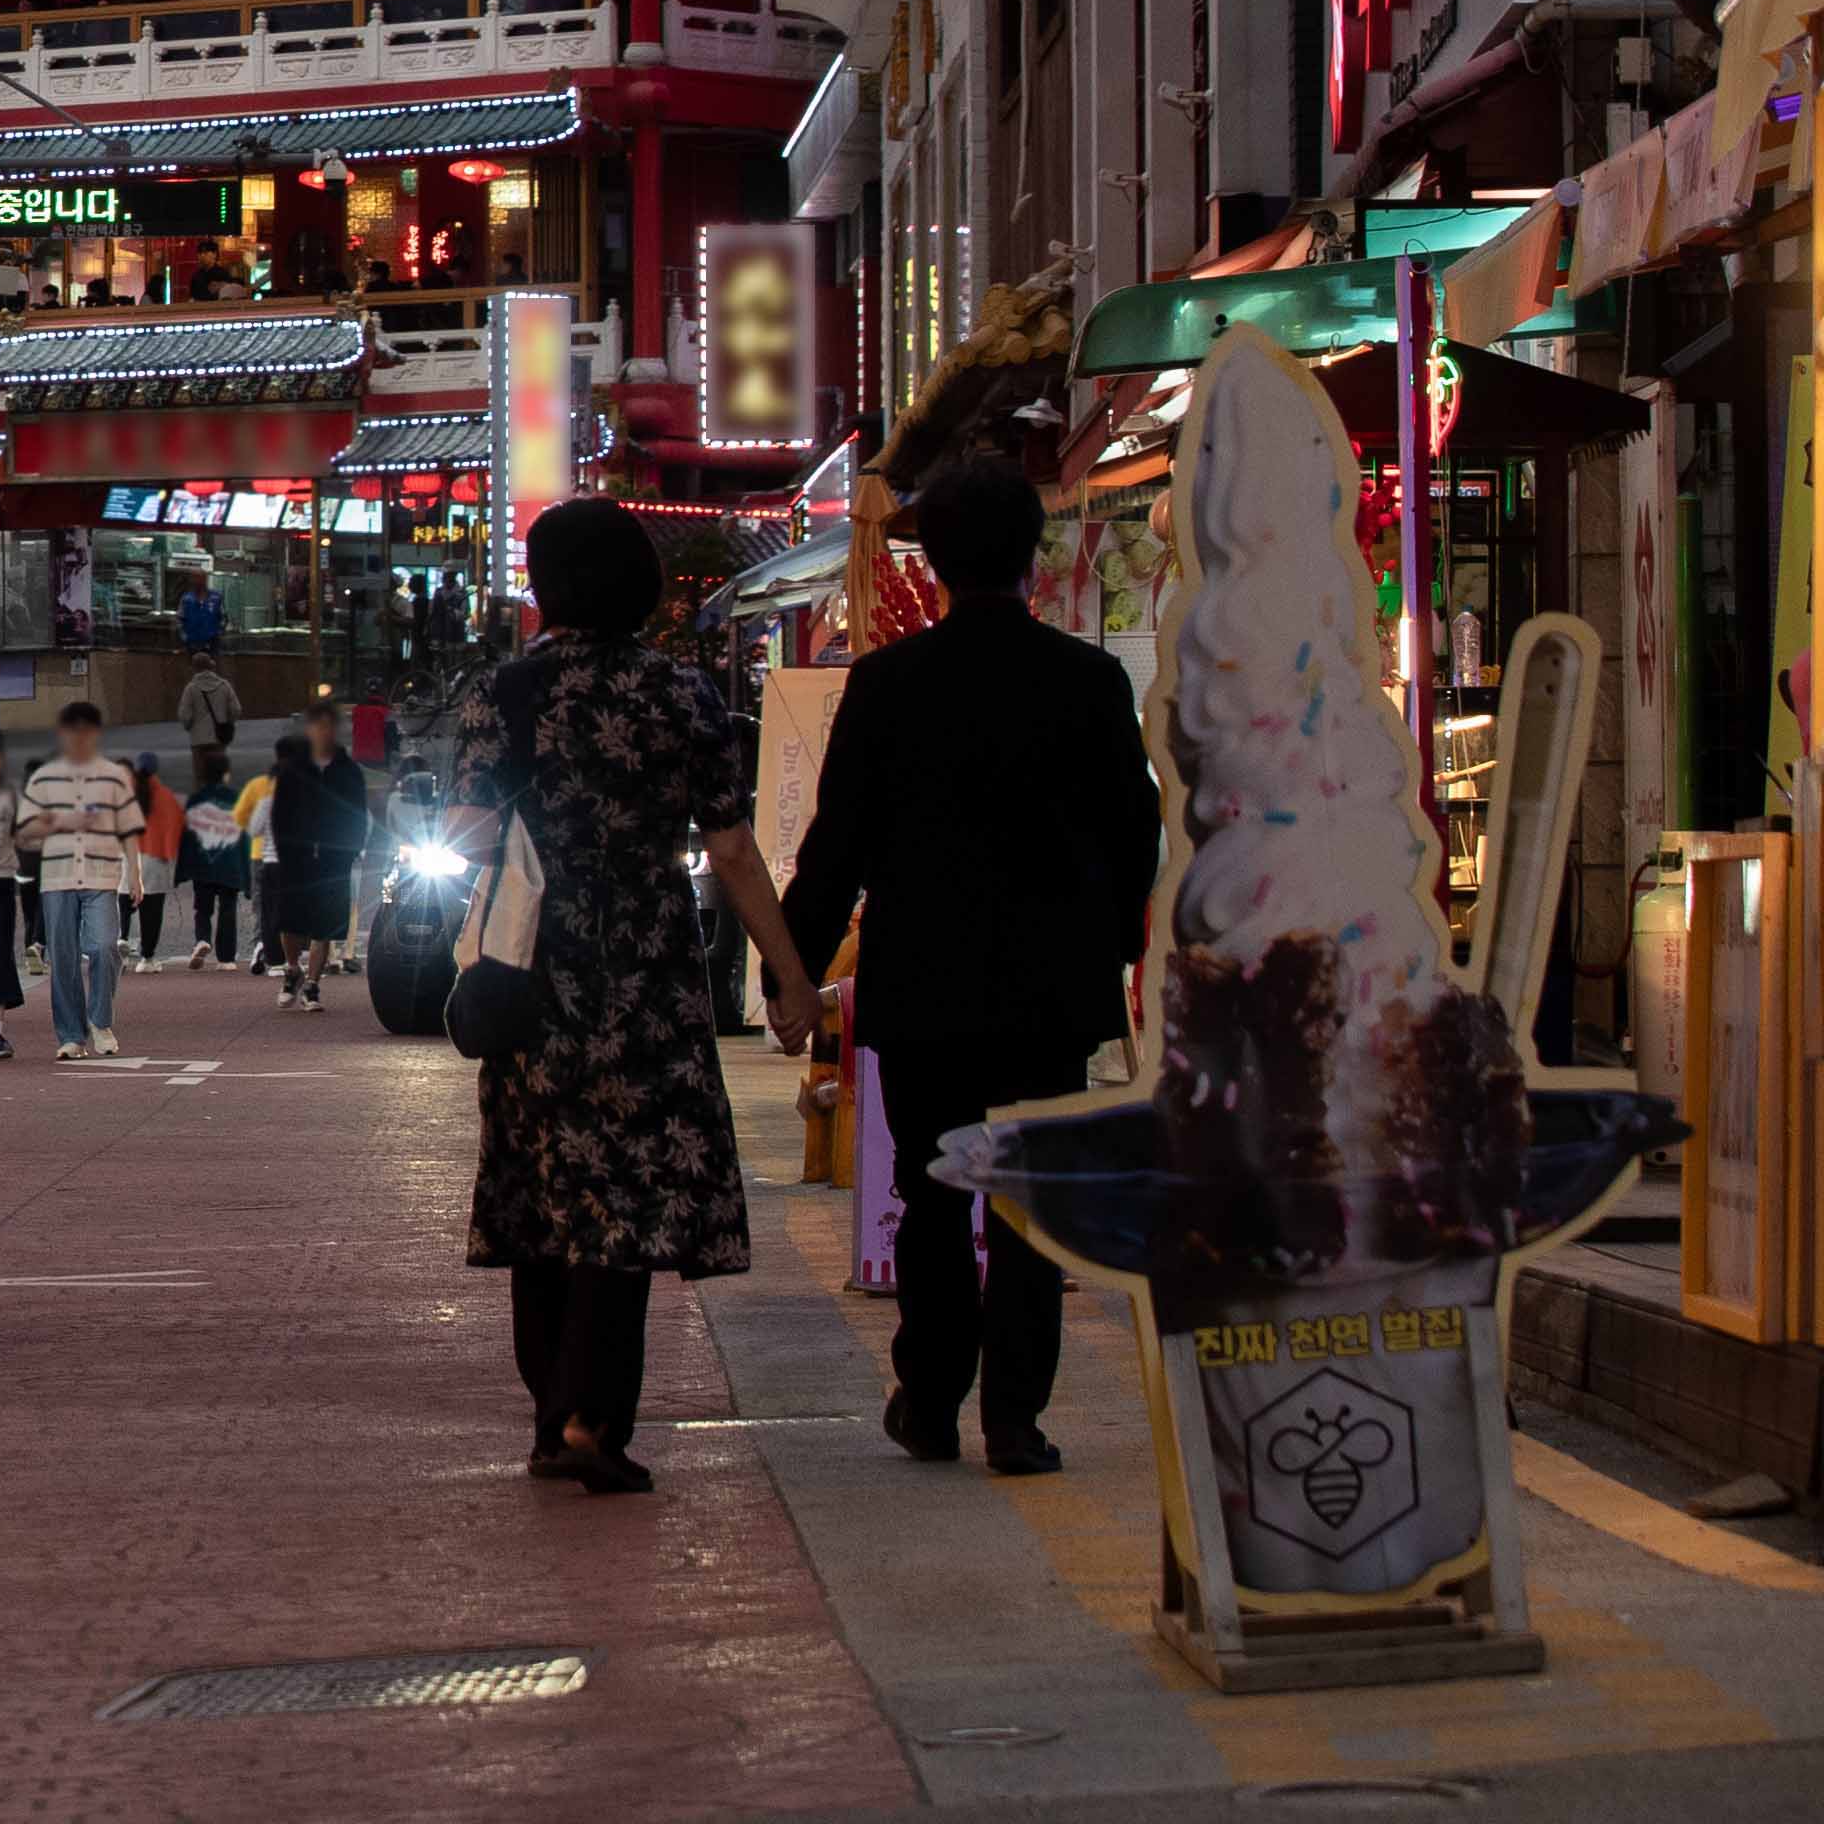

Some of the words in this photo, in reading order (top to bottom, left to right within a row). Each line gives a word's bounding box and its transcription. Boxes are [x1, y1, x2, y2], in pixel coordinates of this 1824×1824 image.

[1195, 1322, 1278, 1368] 진짜
[1288, 1312, 1371, 1360] 천연
[1381, 1304, 1464, 1353] 벌집
